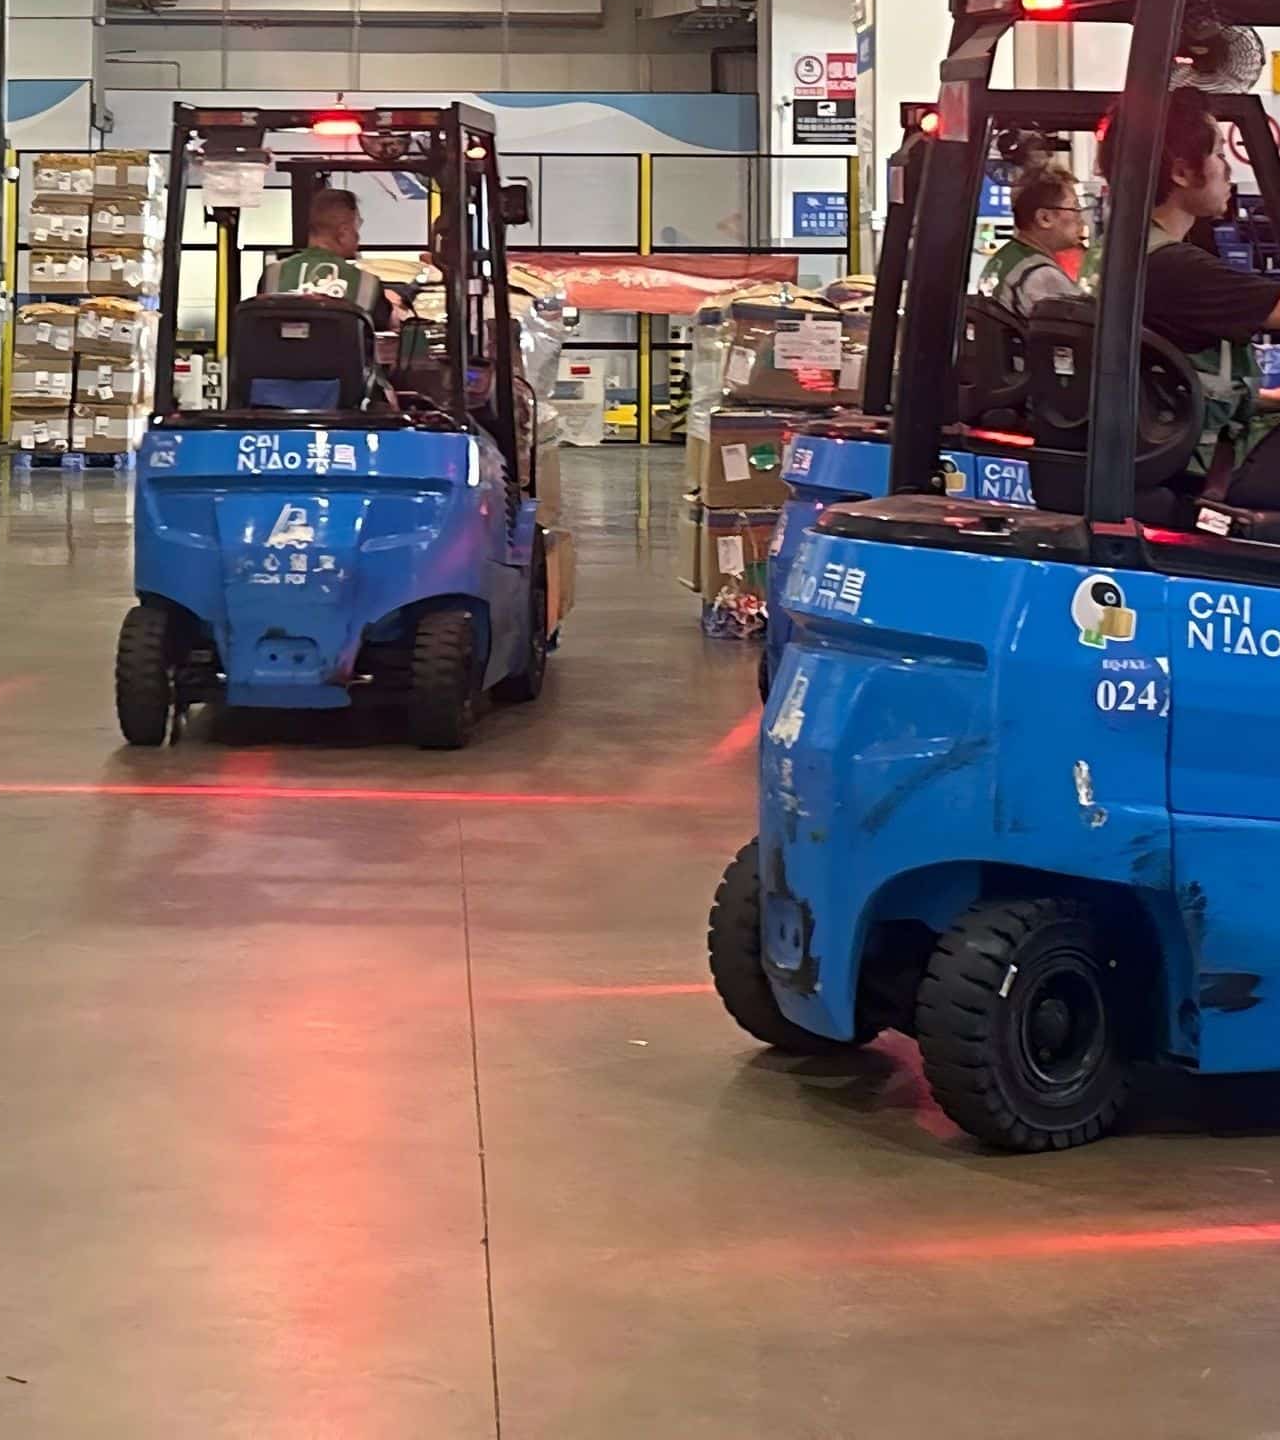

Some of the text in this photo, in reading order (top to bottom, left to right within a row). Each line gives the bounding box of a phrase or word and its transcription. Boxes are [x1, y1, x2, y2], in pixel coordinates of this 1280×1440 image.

[239, 435, 280, 453] CAI
[984, 463, 1024, 484] CAI
[1188, 591, 1251, 624] CAI
[1096, 679, 1158, 711] 024
